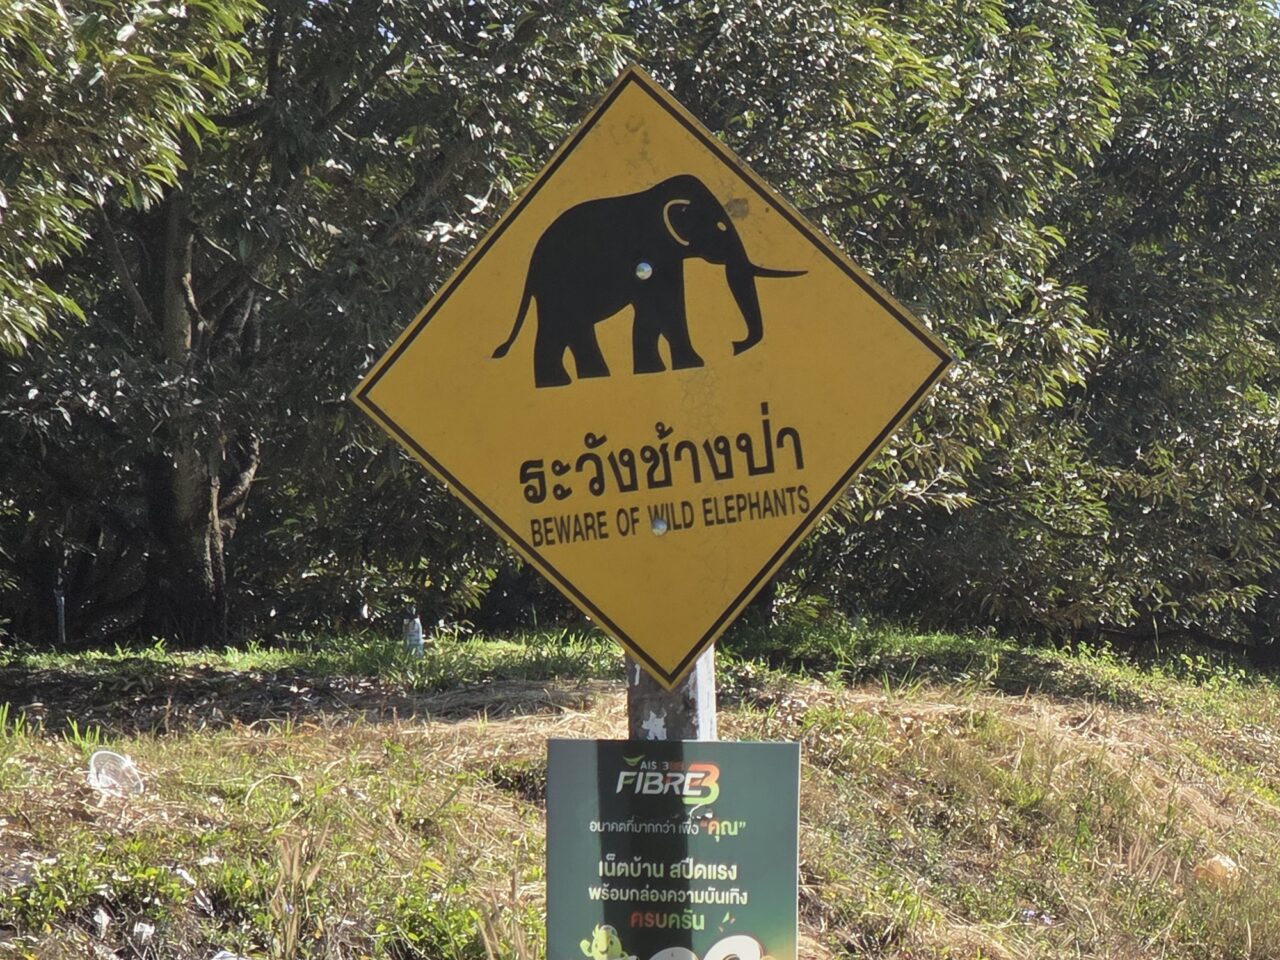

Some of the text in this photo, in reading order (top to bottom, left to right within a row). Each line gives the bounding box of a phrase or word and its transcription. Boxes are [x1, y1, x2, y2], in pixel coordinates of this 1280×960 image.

[519, 401, 804, 504] ระวังช้างป่า
[530, 484, 811, 548] BEWARE OF WILD ELEPHANTS
[640, 761, 657, 770] AIS
[598, 854, 737, 881] เน็ตบ้าน สปีดแรง
[588, 883, 748, 905] พร้อมกล่องความบันเทิง
[630, 908, 705, 931] ครบครัน
